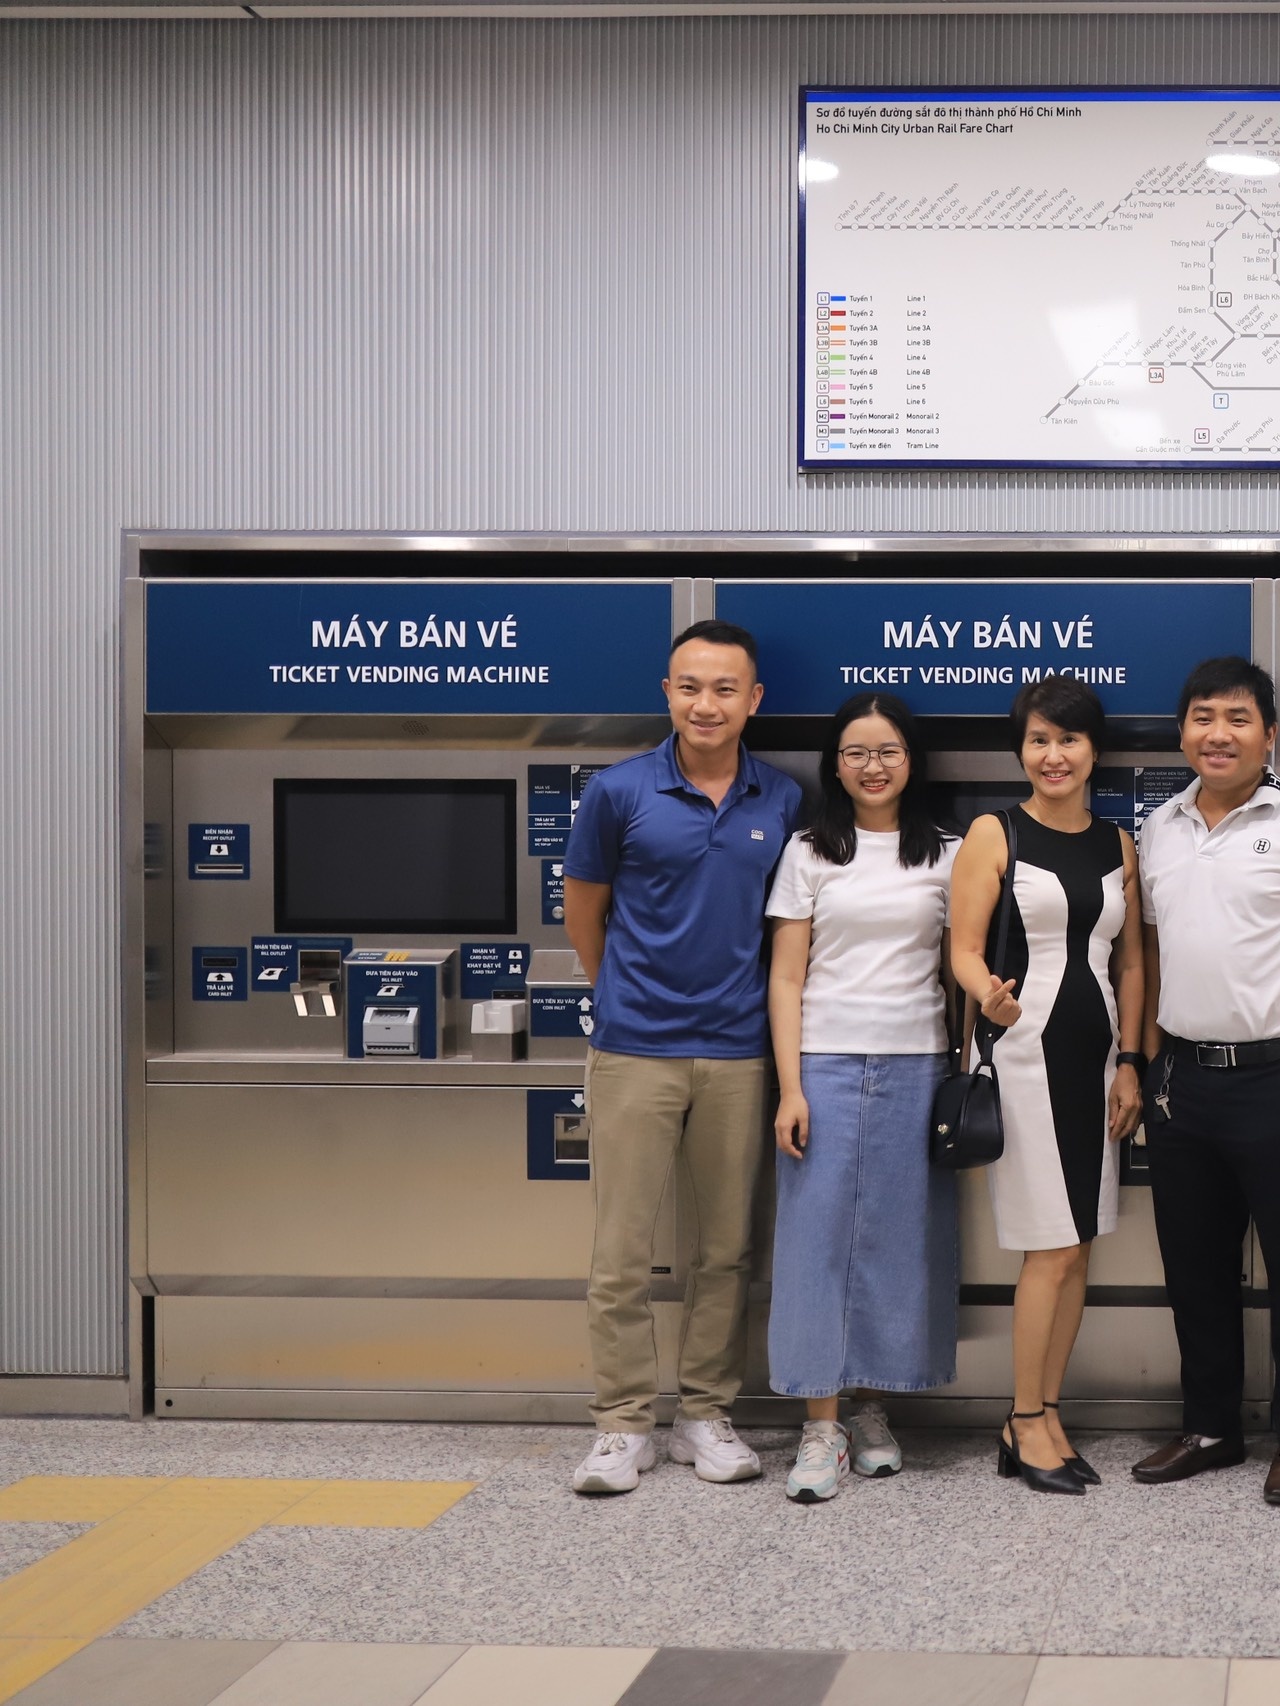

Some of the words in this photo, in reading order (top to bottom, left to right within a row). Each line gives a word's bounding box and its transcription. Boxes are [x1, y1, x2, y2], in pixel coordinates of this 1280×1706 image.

[817, 108, 830, 117] Sơ
[833, 107, 845, 117] đồ
[848, 106, 876, 119] tuyến
[880, 108, 912, 119] đường
[916, 105, 930, 117] sắt
[934, 108, 946, 117] đô
[949, 108, 962, 119] thị
[965, 107, 994, 117] thành
[998, 106, 1017, 119] phố
[1020, 106, 1033, 116] Hồ
[1037, 107, 1052, 116] Chí
[1057, 107, 1081, 116] Minh
[817, 124, 830, 133] Ho
[834, 124, 849, 133] Chi
[853, 124, 878, 133] Minh
[881, 124, 900, 135] City
[903, 124, 934, 133] Urban
[938, 124, 957, 133] Rail
[960, 123, 982, 133] Fare
[986, 123, 1013, 133] Chart
[313, 614, 388, 647] MÁY
[400, 614, 465, 647] BÁN
[477, 614, 516, 647] VÉ
[884, 615, 962, 648] MÁY
[974, 615, 1040, 648] BÁN
[1052, 615, 1092, 648] VÉ
[269, 666, 339, 682] TICKET
[347, 666, 438, 682] VENDING
[448, 666, 548, 682] MACHINE
[840, 667, 912, 683] TICKET
[919, 667, 1012, 683] VENDING
